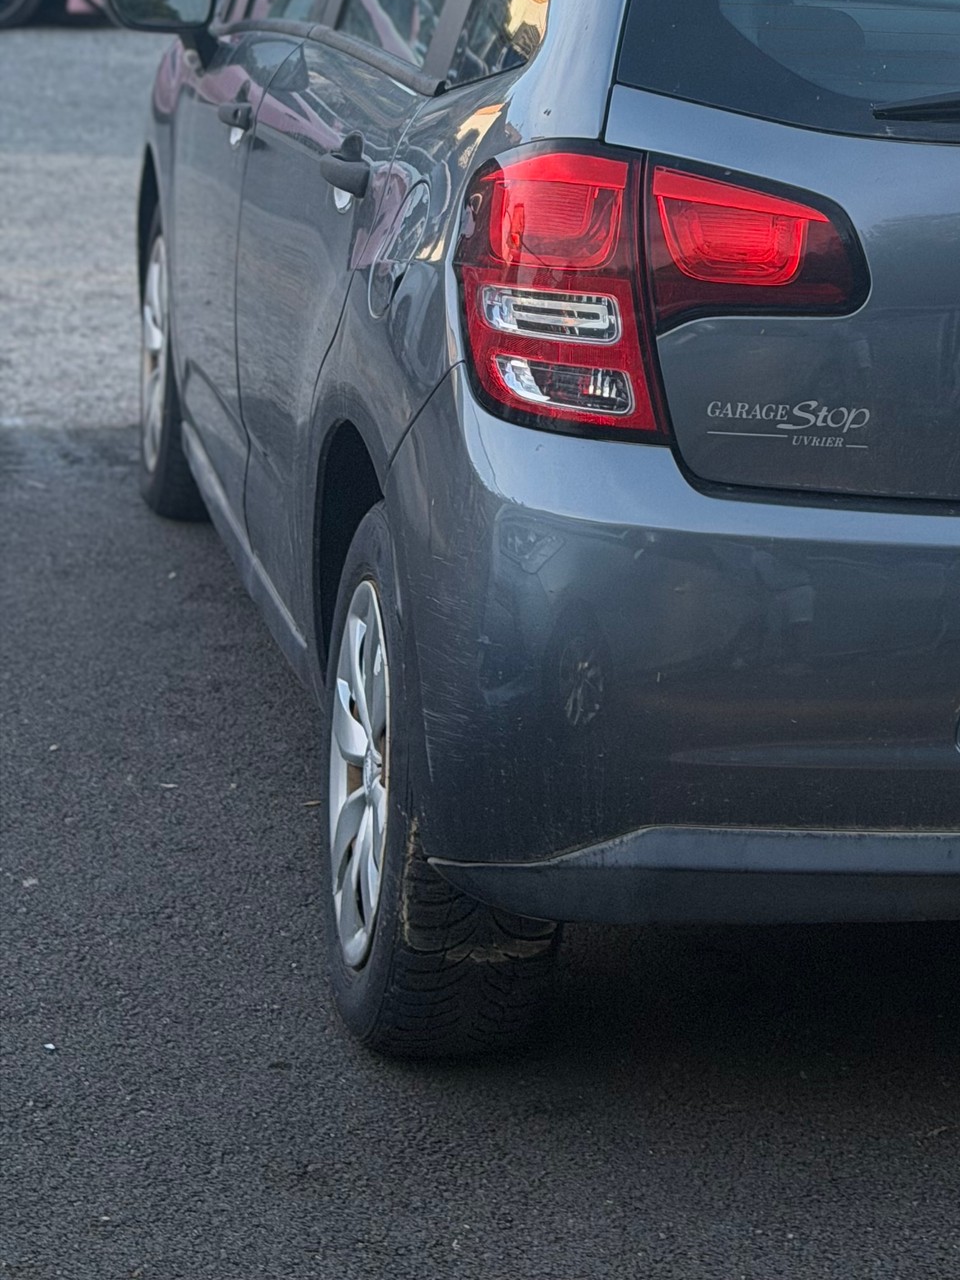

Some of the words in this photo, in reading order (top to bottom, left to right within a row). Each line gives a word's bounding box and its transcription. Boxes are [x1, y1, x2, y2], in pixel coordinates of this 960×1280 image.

[706, 401, 790, 421] GARAGE
[776, 400, 871, 433] Stop
[791, 435, 845, 448] UVRIER
